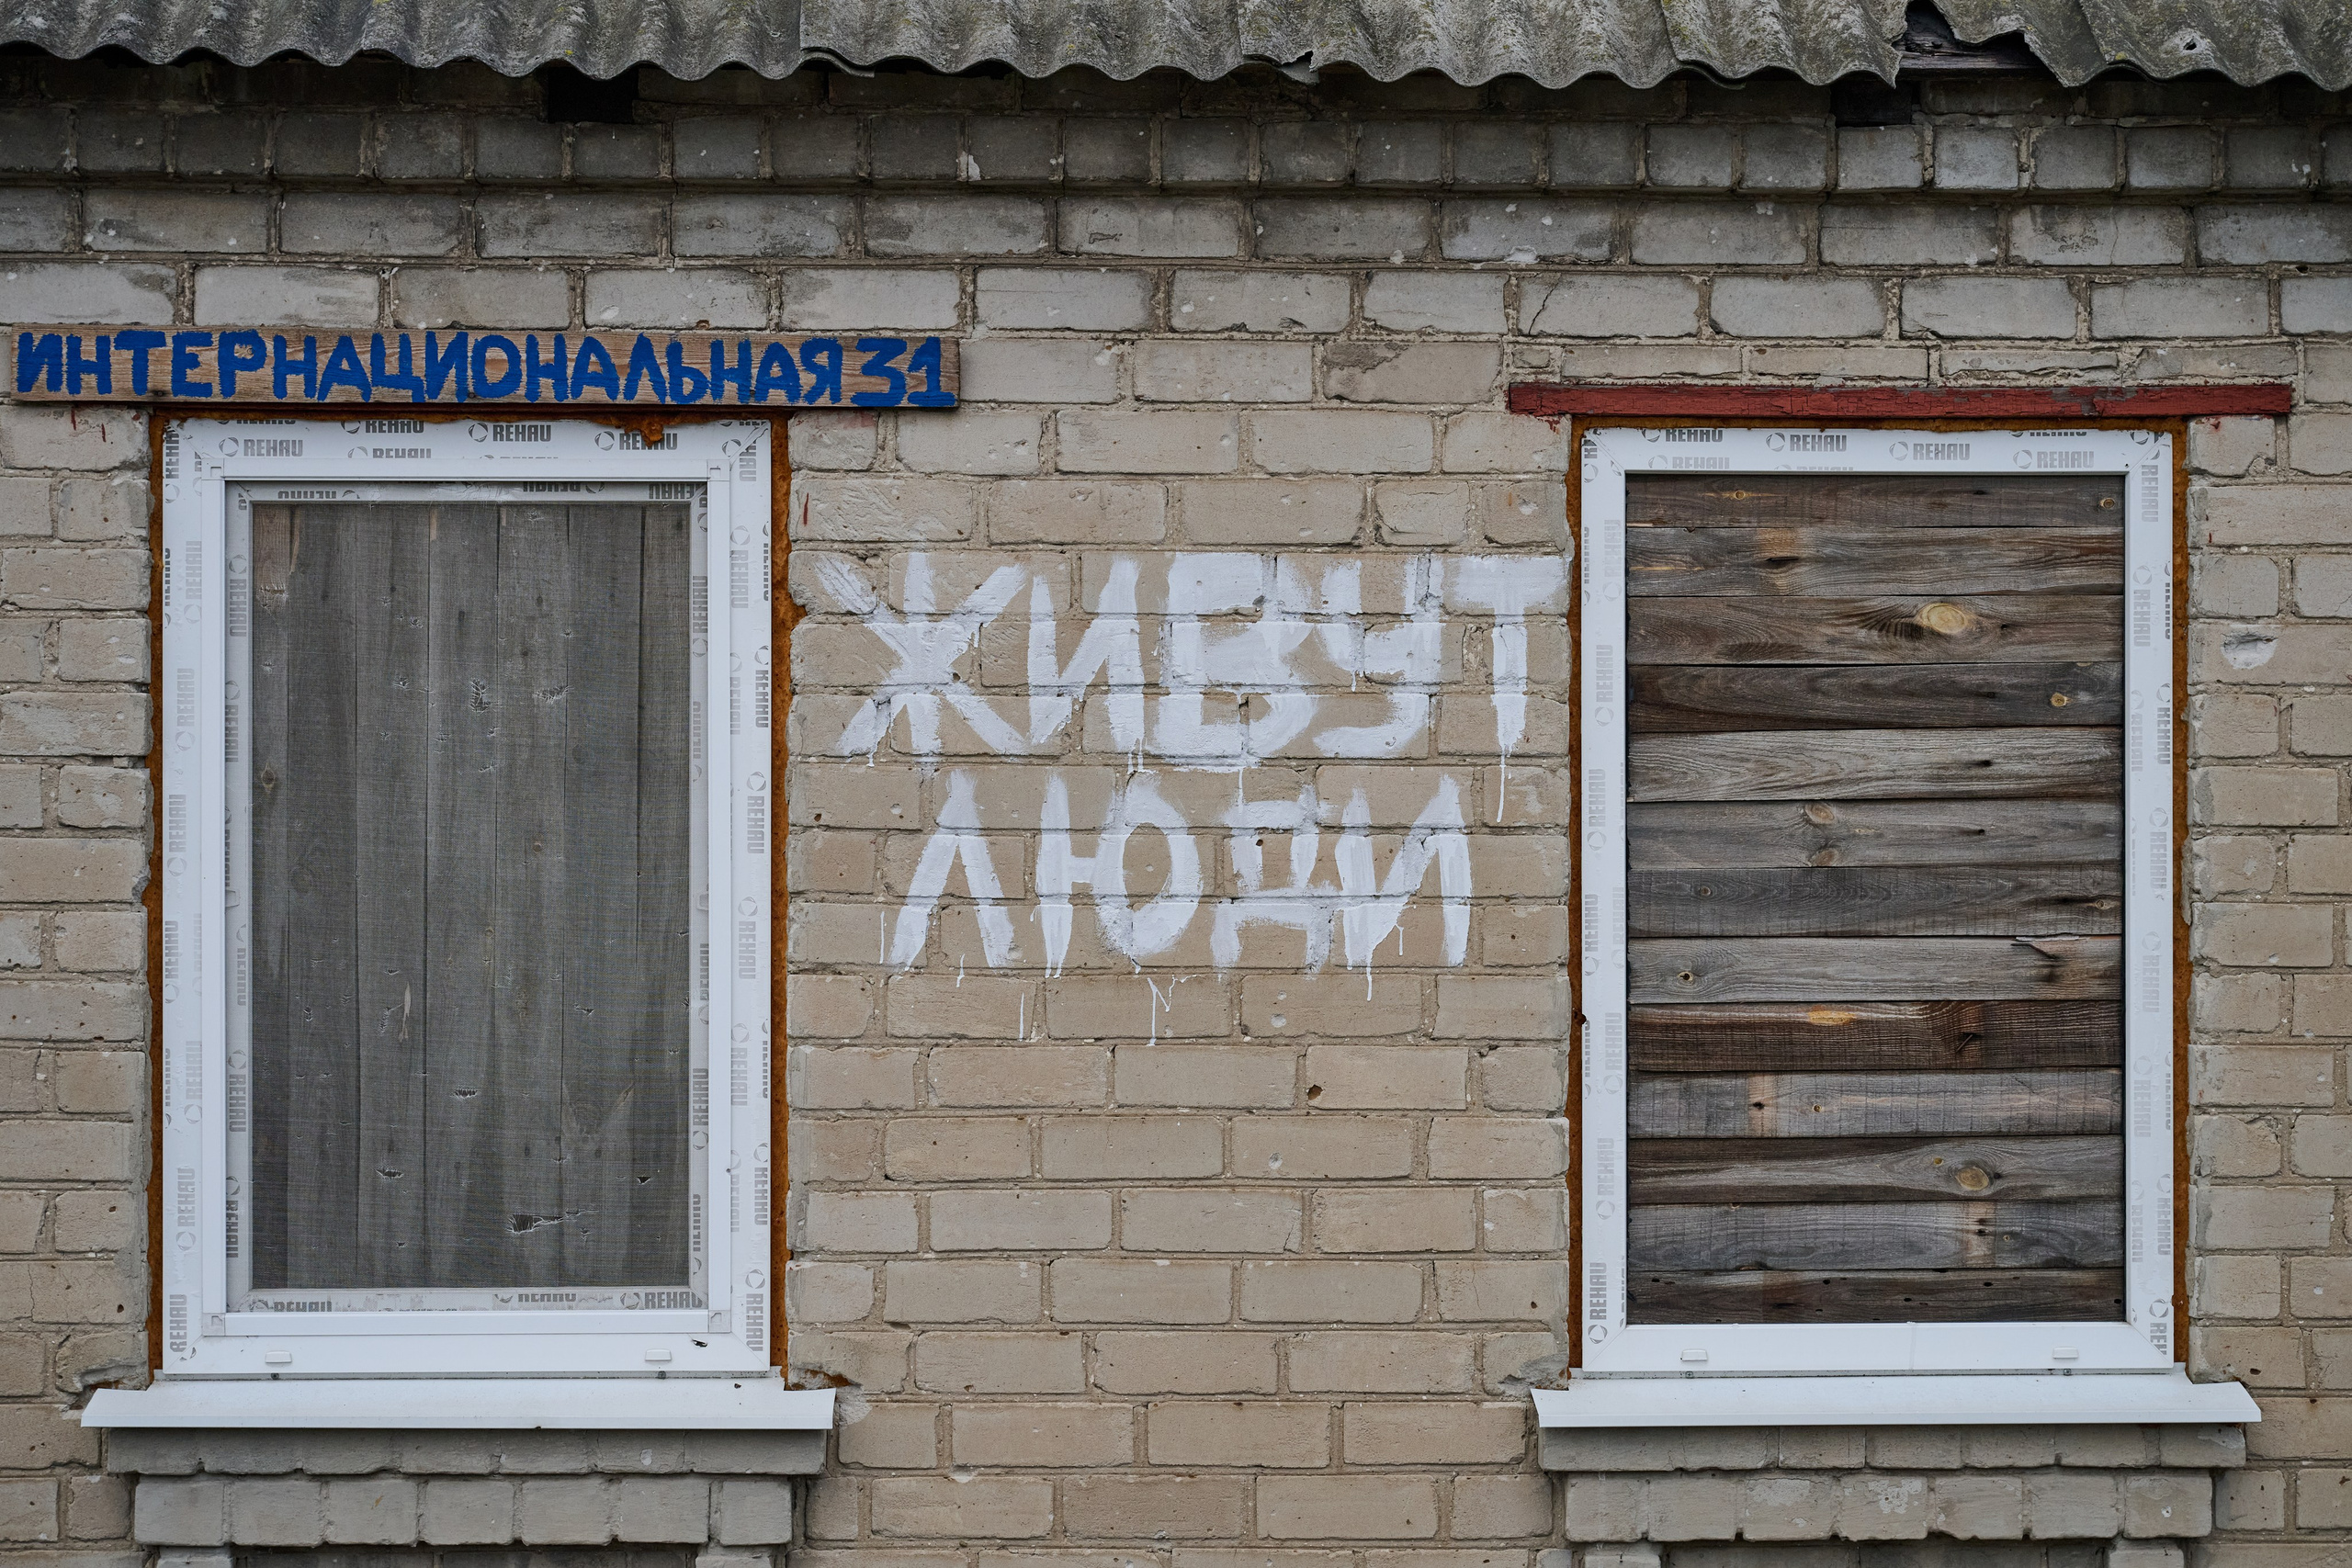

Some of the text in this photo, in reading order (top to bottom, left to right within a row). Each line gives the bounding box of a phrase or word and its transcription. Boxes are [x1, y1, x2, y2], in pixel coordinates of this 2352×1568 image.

[17, 329, 956, 408] ИНТЕРНАЦИОНАЛЬНАЯ 31
[243, 439, 303, 457] REHAU
[492, 424, 551, 442] REHAU
[739, 439, 756, 481] HAU
[1791, 434, 1847, 452] REHAU
[1913, 443, 1970, 460] REHAU
[2037, 451, 2094, 468] REHAU
[2141, 465, 2158, 523] REHAU
[186, 541, 202, 600] REHAU
[730, 550, 748, 609] REHAU
[230, 579, 246, 637] REHAU
[693, 576, 707, 634] REHAU
[2133, 590, 2150, 647] REHAU
[813, 552, 1570, 765] ЖИВУТ
[1596, 644, 1612, 702] REHAU
[177, 668, 194, 727] REHAU
[169, 795, 187, 852] REHAU
[747, 795, 764, 854] REHAU
[1589, 769, 1606, 827] REHAU
[888, 771, 1472, 976] ЛЮДИ
[2150, 832, 2167, 889] REHAU
[739, 921, 756, 979] REHAU
[2143, 954, 2159, 1012] REHAU
[1605, 1012, 1622, 1070] REHAU
[185, 1041, 202, 1100] REHAU
[693, 1068, 708, 1126] REHAU
[730, 1048, 748, 1107] REHAU
[229, 1074, 245, 1133] REHAU
[2133, 1079, 2151, 1137] REHAU
[1598, 1138, 1614, 1196] REHAU
[177, 1168, 195, 1227] REHAU
[1589, 1262, 1607, 1321] REHAU
[169, 1294, 187, 1353] REHAU
[746, 1293, 763, 1352] REHAU
